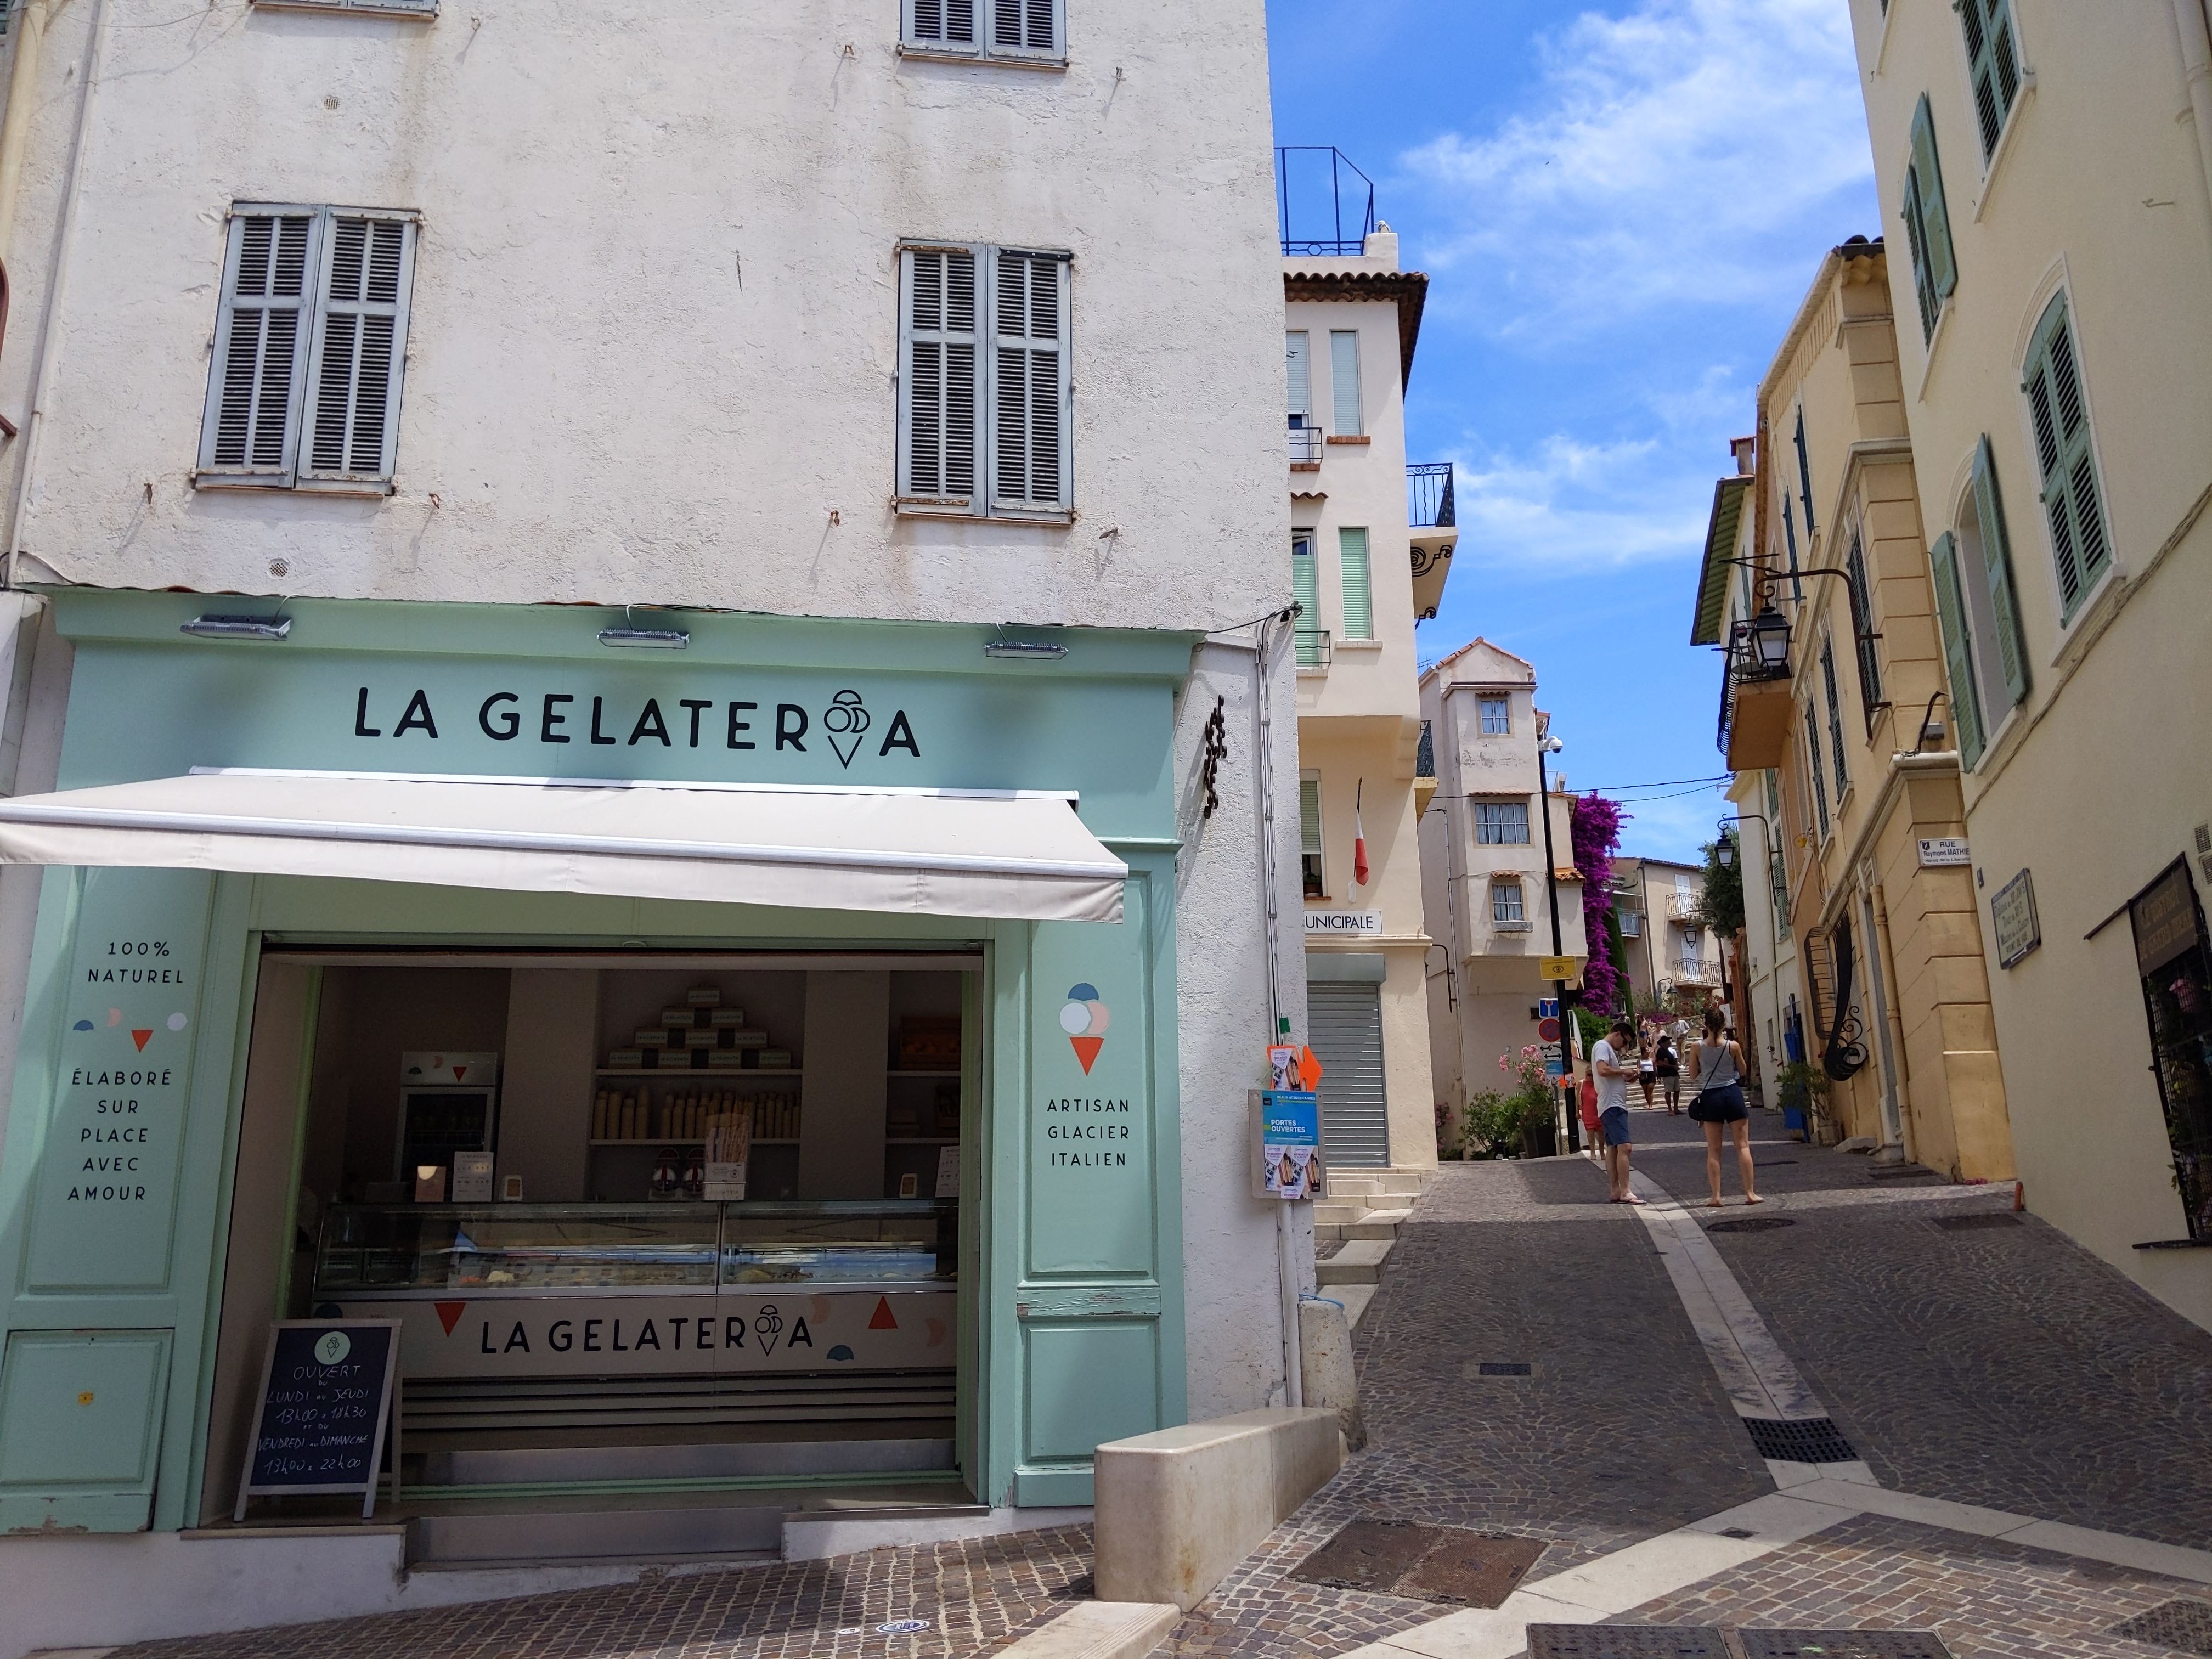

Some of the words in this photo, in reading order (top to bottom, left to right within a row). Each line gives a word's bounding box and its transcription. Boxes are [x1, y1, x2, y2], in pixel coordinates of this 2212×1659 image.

[354, 686, 439, 739] LA
[1305, 916, 1373, 929] UNICIPALE
[108, 941, 170, 957] 100%
[88, 969, 184, 983] NATUREL
[71, 1068, 172, 1085] ÉLABORÉ
[97, 1100, 138, 1114] SUR
[1047, 1099, 1129, 1112] ARTISAN
[81, 1128, 148, 1143] PLACE
[1048, 1126, 1129, 1139] GLACIER
[82, 1157, 139, 1171] AVEC
[1052, 1153, 1125, 1166] ITALIEN
[67, 1186, 146, 1200] AMOUR
[481, 1321, 531, 1353] LA
[293, 1365, 360, 1380] OUVERT
[266, 1390, 308, 1404] LUNDI
[332, 1389, 369, 1402] JEUDI
[276, 1408, 318, 1424] 13h00
[330, 1406, 366, 1420] 18h30
[258, 1437, 305, 1451] VENDREDI
[320, 1435, 368, 1447] DIMANCHE
[320, 1454, 362, 1470] 22h00
